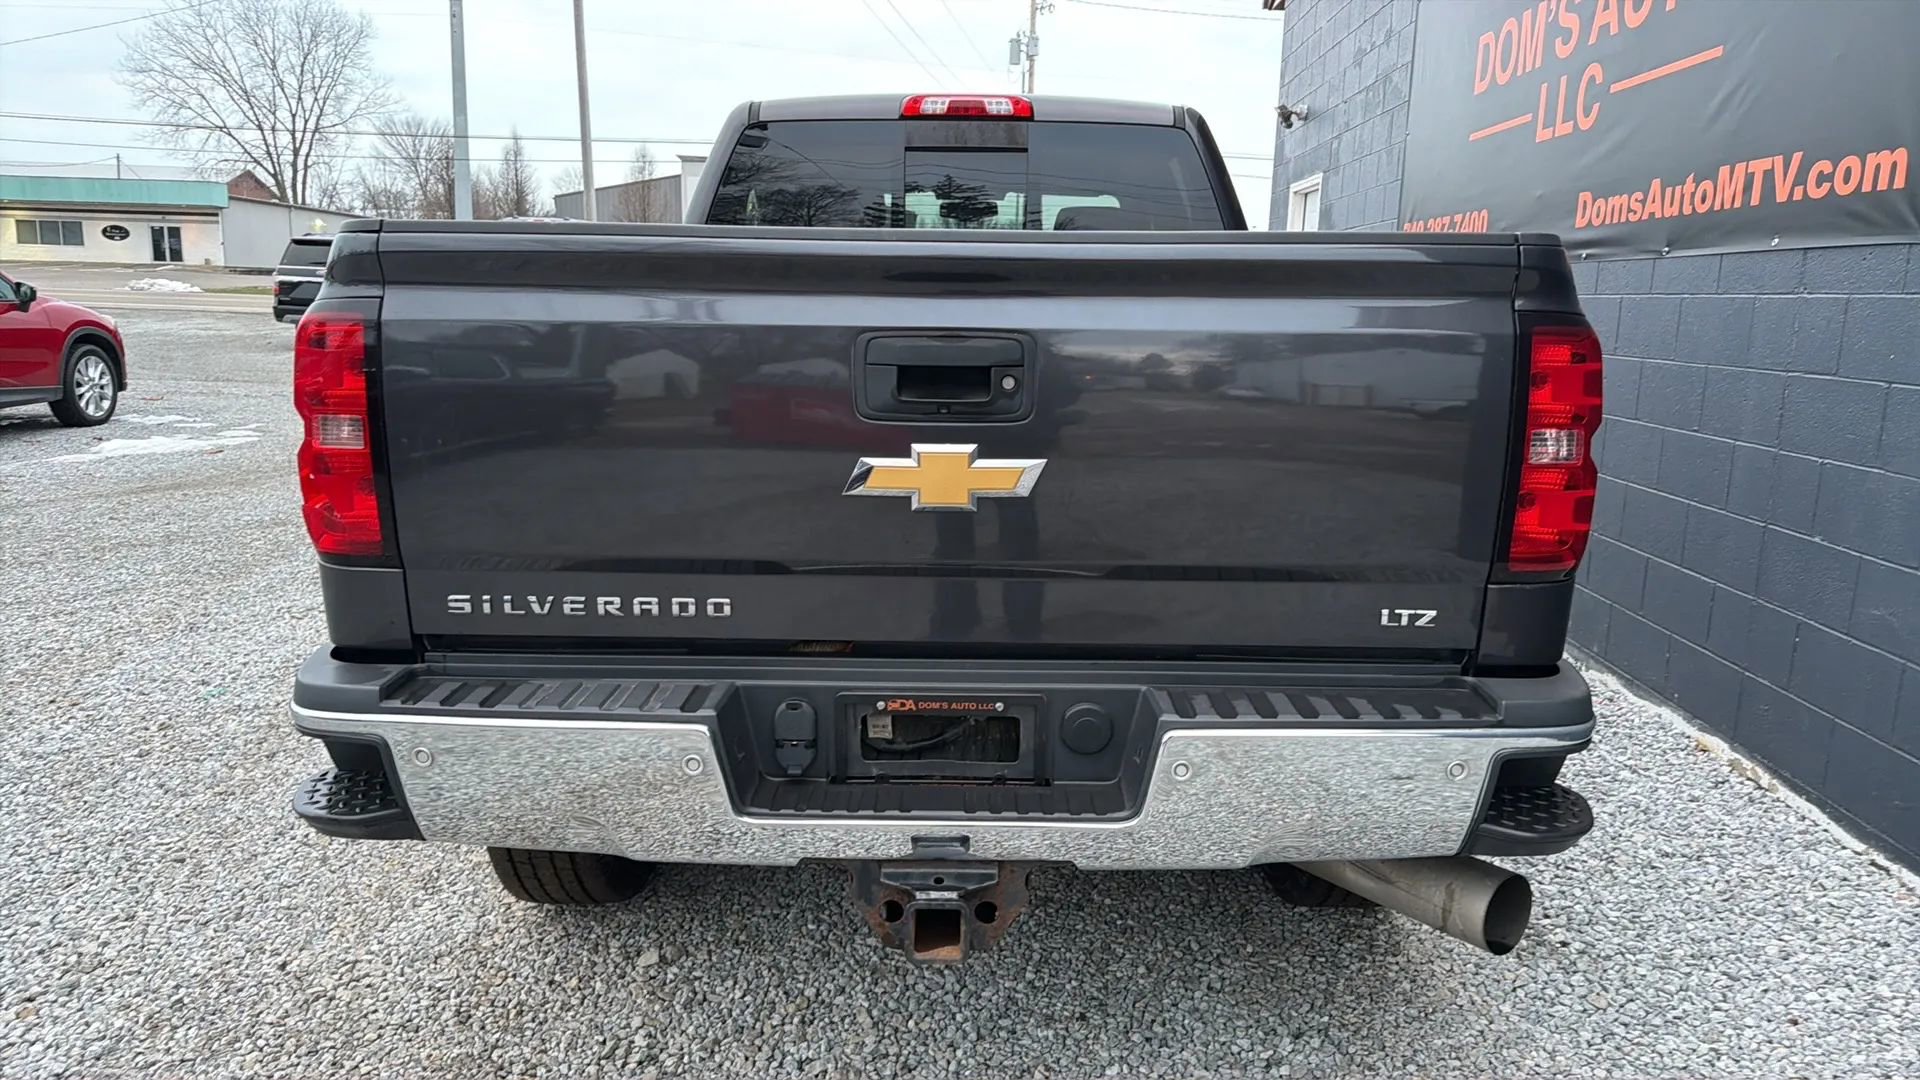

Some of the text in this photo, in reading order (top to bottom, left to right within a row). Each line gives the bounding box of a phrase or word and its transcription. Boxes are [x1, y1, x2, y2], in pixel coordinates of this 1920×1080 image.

[1473, 0, 1581, 95] DOM'S
[1535, 62, 1603, 143] LLC
[1574, 146, 1909, 229] DomsAutoMTV.com
[1403, 208, 1489, 232] 287-7400
[447, 594, 732, 617] SILVERADO
[1380, 608, 1438, 627] LTZ
[918, 702, 949, 710] DOM'S
[950, 702, 977, 710] AUTO
